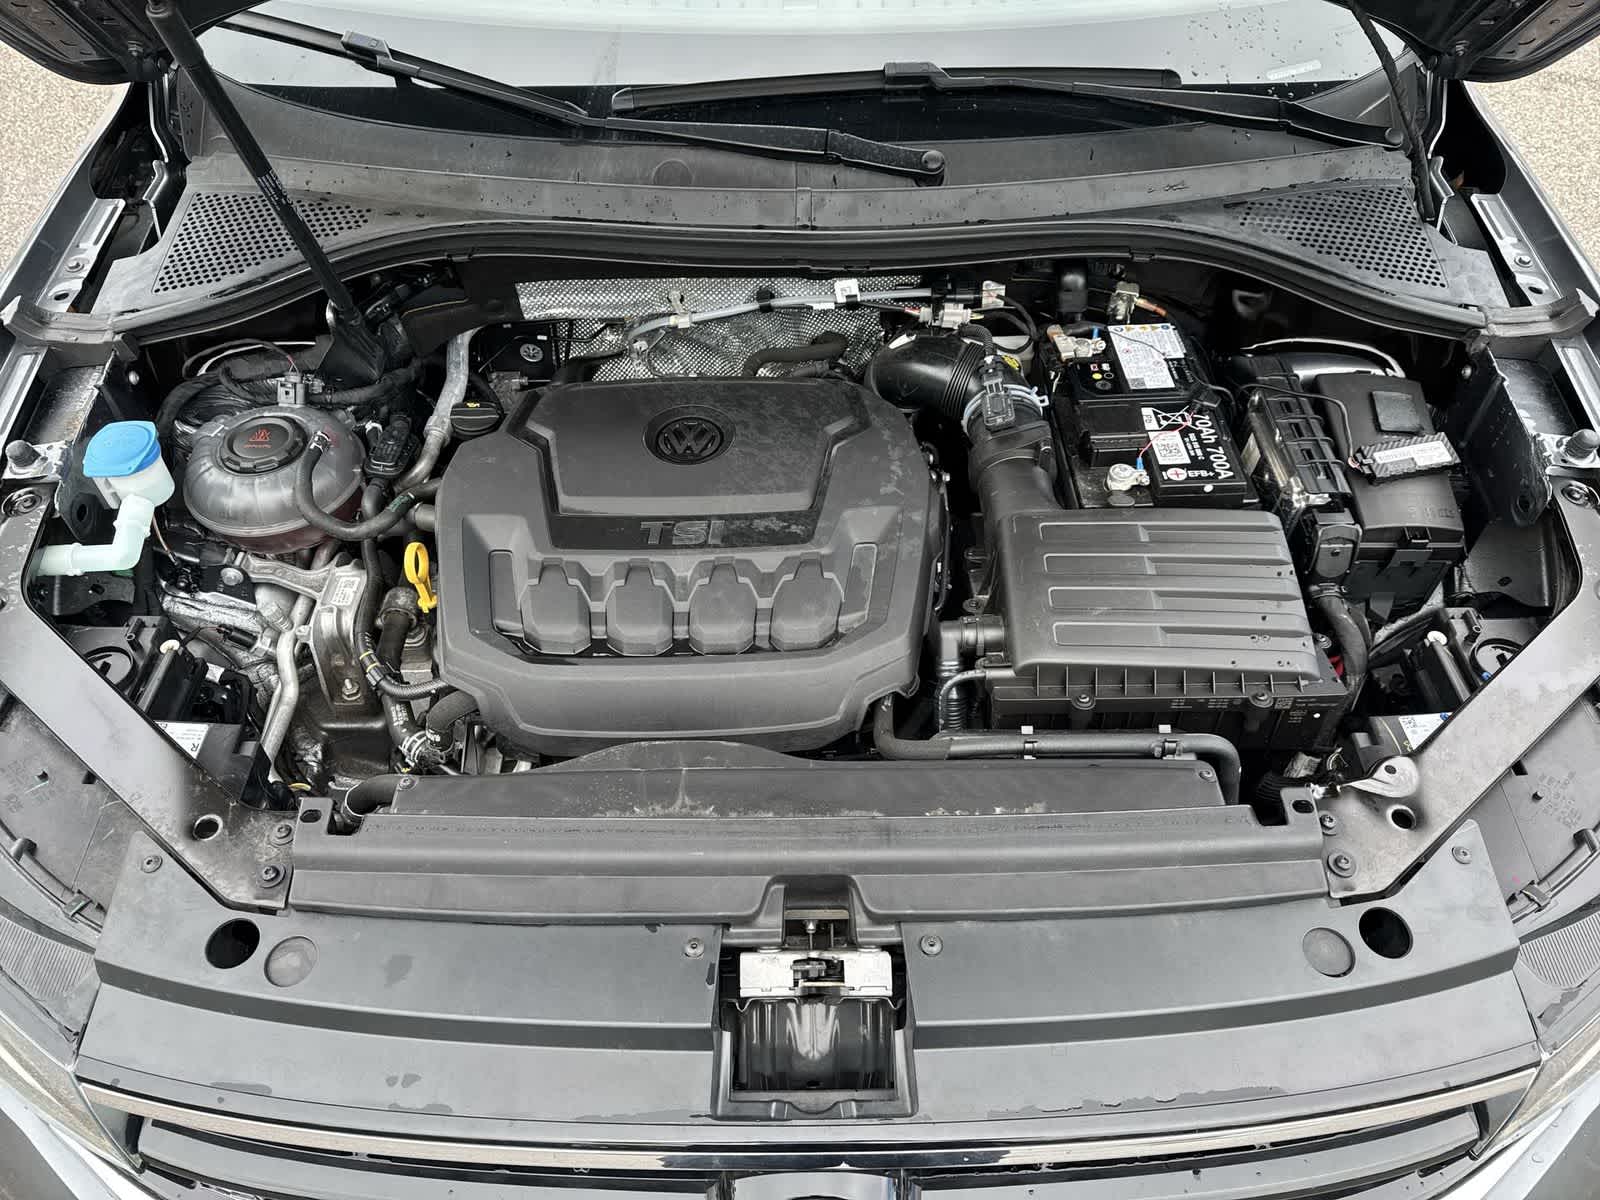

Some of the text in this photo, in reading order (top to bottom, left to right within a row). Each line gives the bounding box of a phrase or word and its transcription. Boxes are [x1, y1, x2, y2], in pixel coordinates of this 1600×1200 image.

[1193, 414, 1218, 444] 70Ah
[1206, 446, 1234, 480] 700A
[640, 519, 726, 546] TSI
